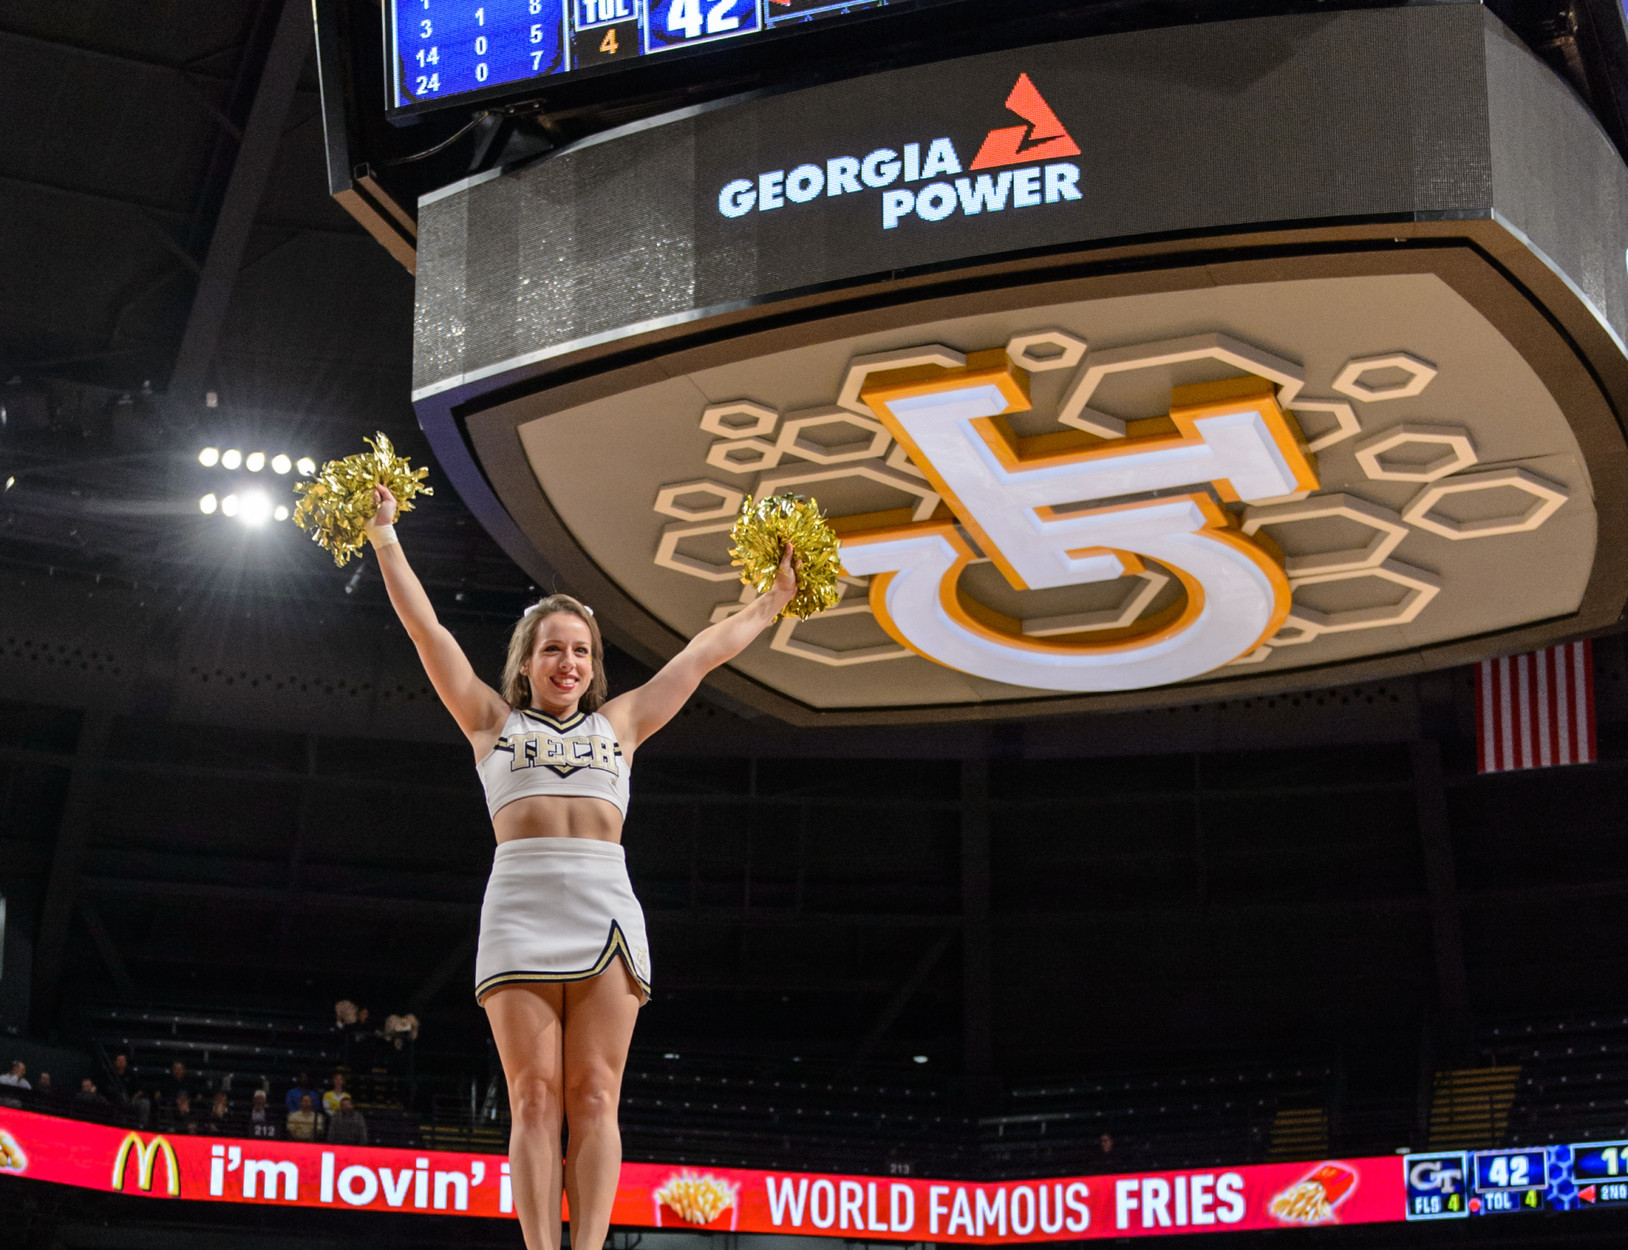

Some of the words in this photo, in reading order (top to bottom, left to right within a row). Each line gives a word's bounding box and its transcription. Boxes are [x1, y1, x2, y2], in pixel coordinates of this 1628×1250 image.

[420, 19, 433, 39] 3
[475, 7, 485, 27] 1
[599, 28, 619, 55] 4
[667, 0, 740, 39] 42
[416, 46, 440, 68] 14
[475, 36, 488, 56] 0
[530, 24, 543, 44] 5
[416, 72, 441, 96] 24
[475, 62, 489, 83] 0
[530, 50, 544, 71] 7
[718, 137, 963, 219] GEORGIA
[882, 162, 1084, 230] POWER
[506, 731, 620, 778] TECH
[499, 1162, 514, 1214] i
[1488, 1156, 1530, 1187] 42
[766, 1176, 914, 1233] WORLD
[928, 1182, 1090, 1237] FAMOUS
[1116, 1172, 1244, 1229] FRIES
[1415, 1195, 1441, 1214] FLS
[1448, 1193, 1460, 1212] 4
[1484, 1191, 1512, 1210] TOL
[1525, 1190, 1538, 1208] 4
